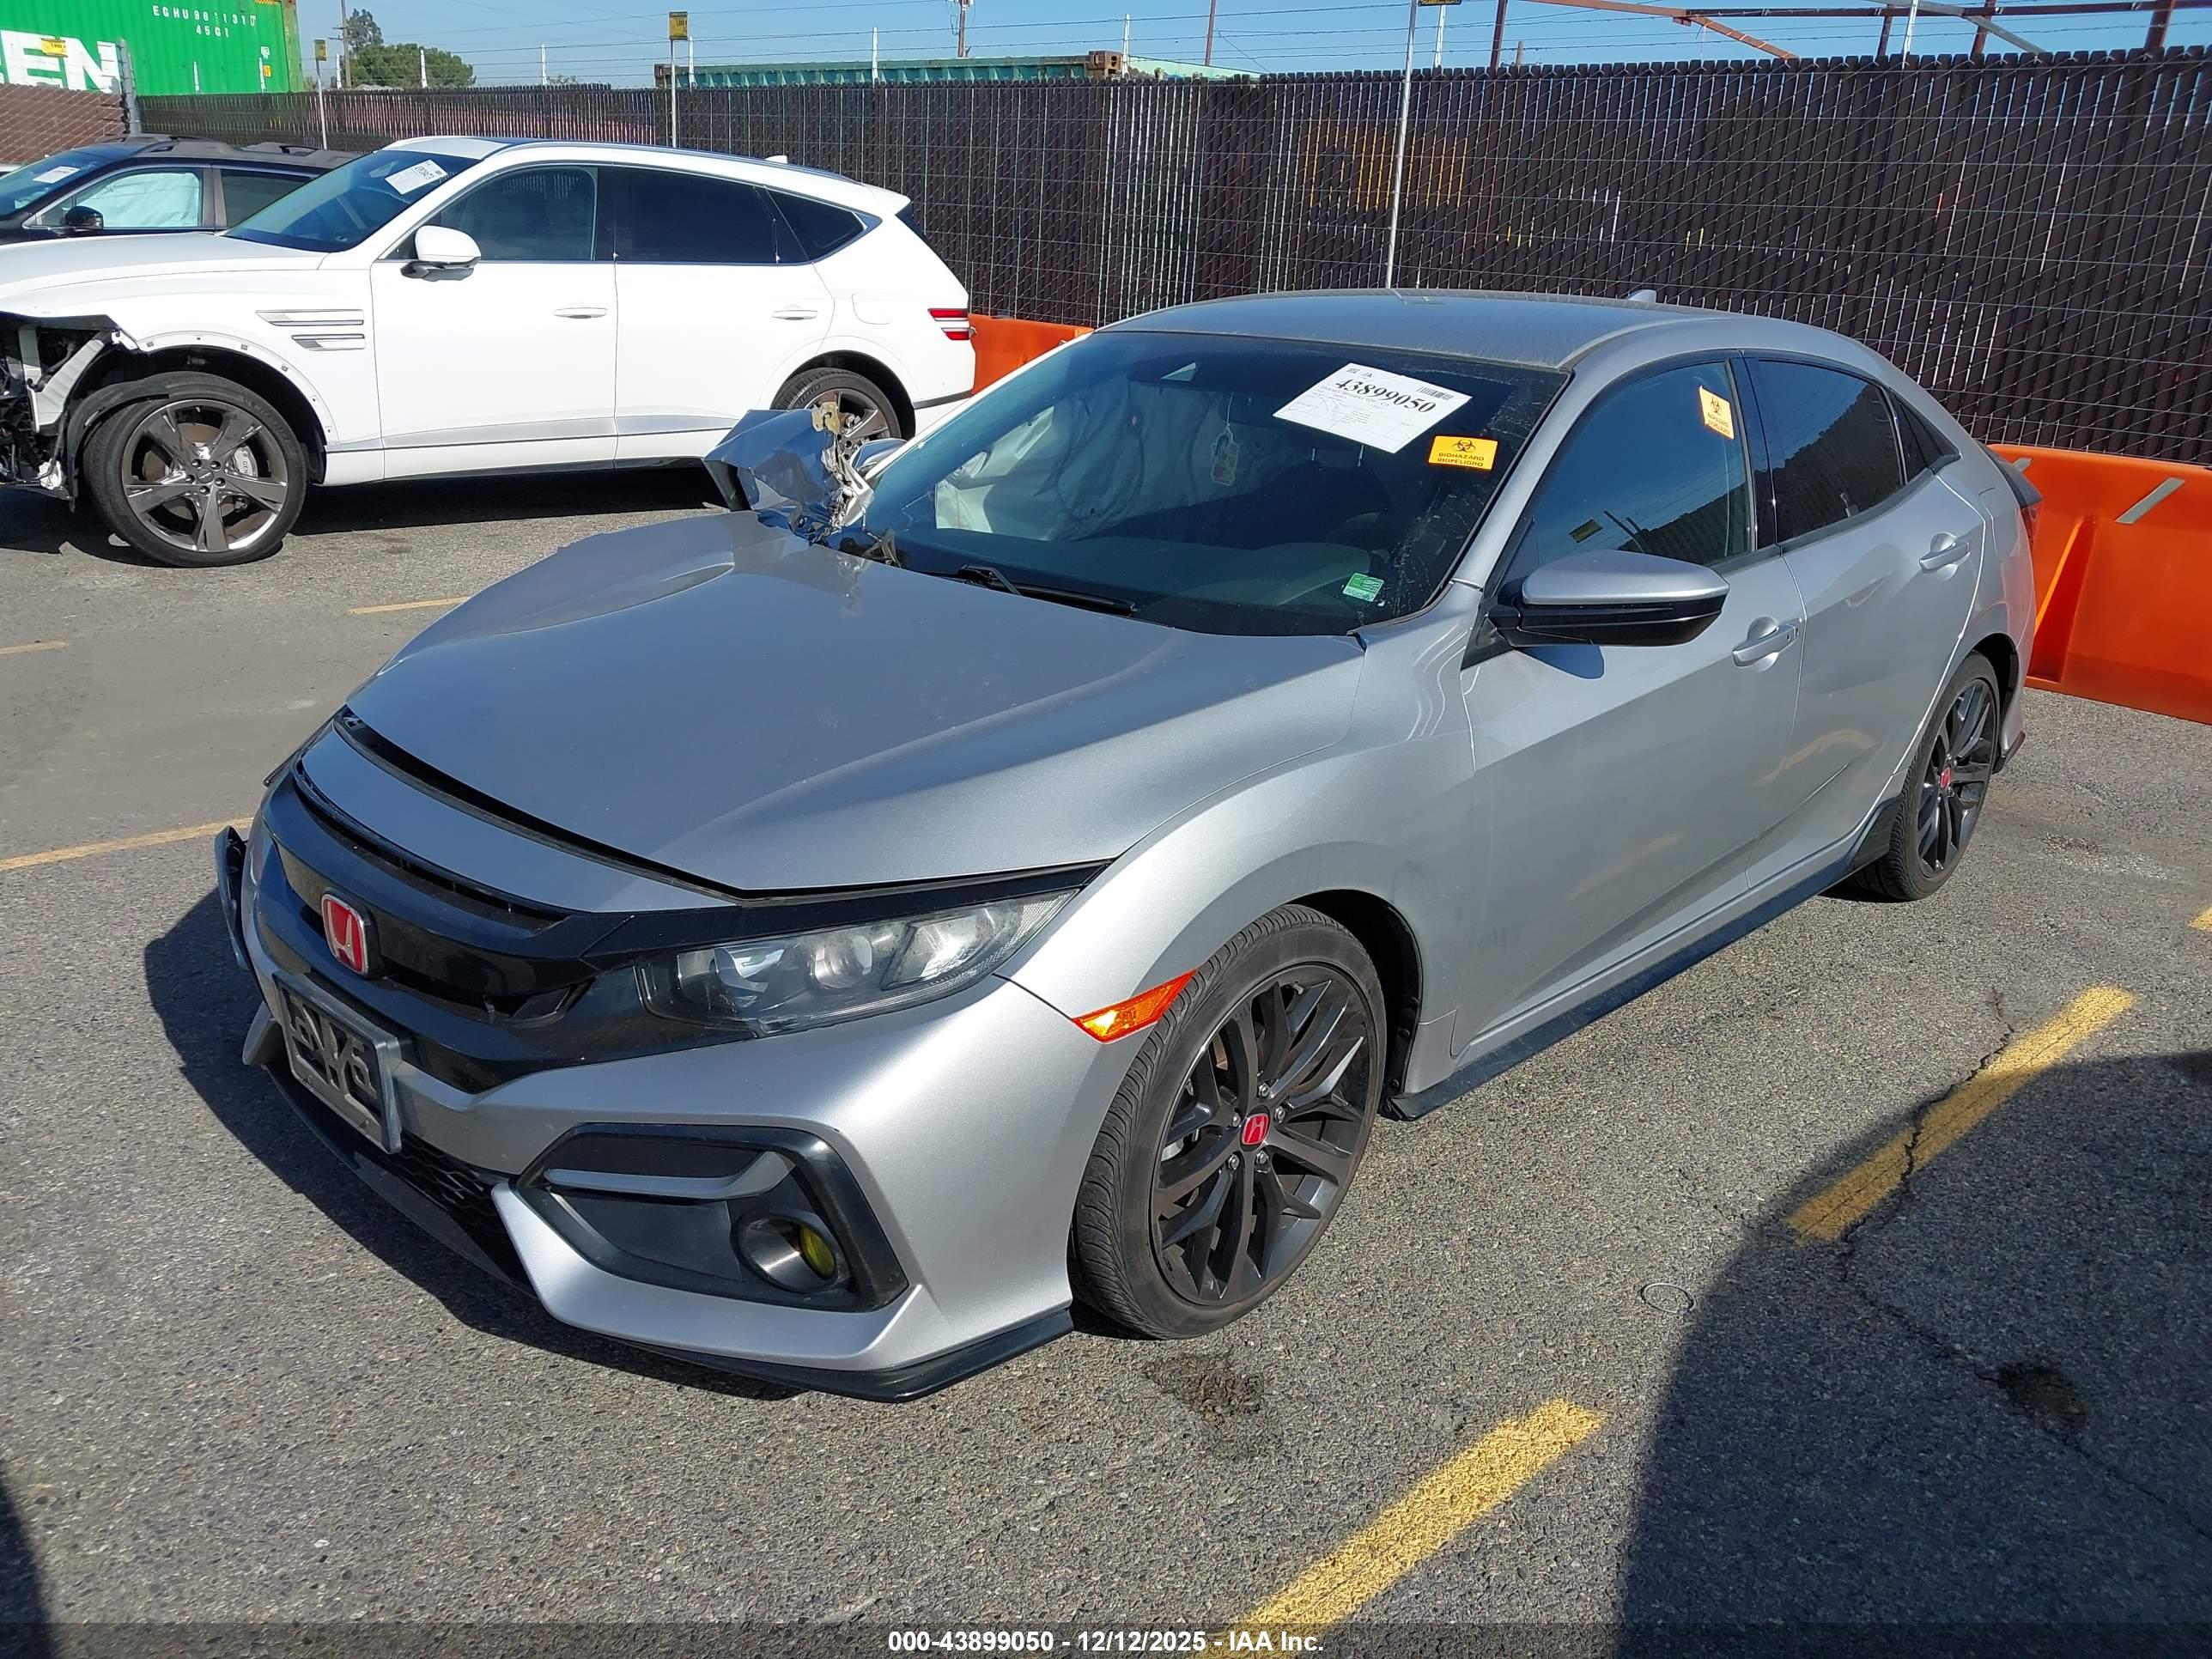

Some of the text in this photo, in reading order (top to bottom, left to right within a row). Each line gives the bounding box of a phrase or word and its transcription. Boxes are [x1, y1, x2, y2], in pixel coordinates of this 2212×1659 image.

[152, 5, 190, 20] EGHU
[0, 29, 122, 94] EN
[1336, 379, 1437, 413] 43899050
[1438, 452, 1485, 461] BIOHAZARD
